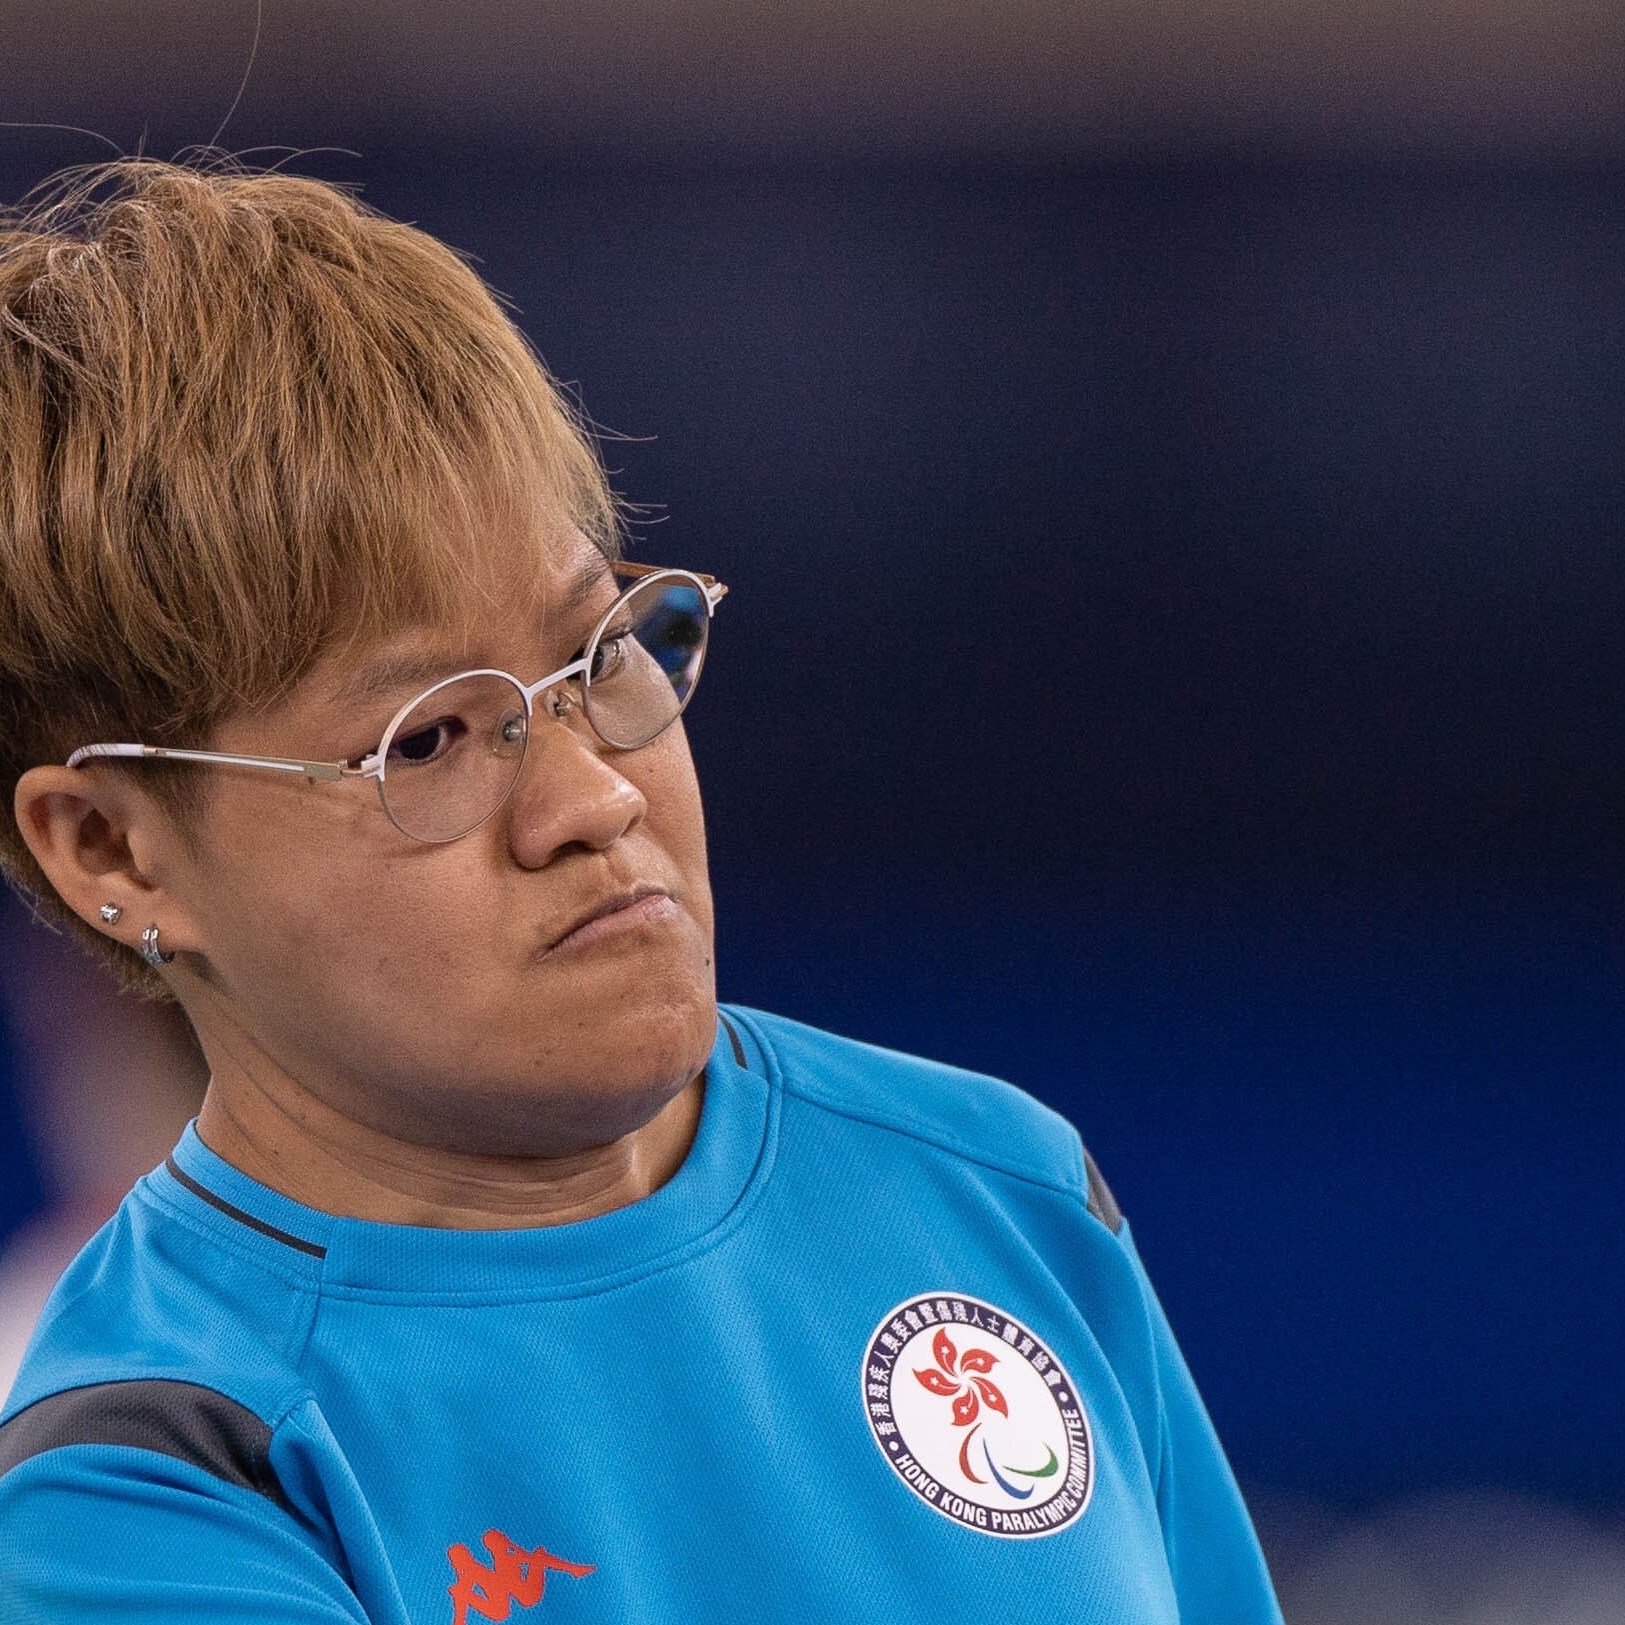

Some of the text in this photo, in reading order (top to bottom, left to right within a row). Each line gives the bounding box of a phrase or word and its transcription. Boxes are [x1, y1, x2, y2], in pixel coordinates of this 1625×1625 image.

[894, 1408, 1088, 1532] HONG KONG PARALYMPIC COMMITTEE
